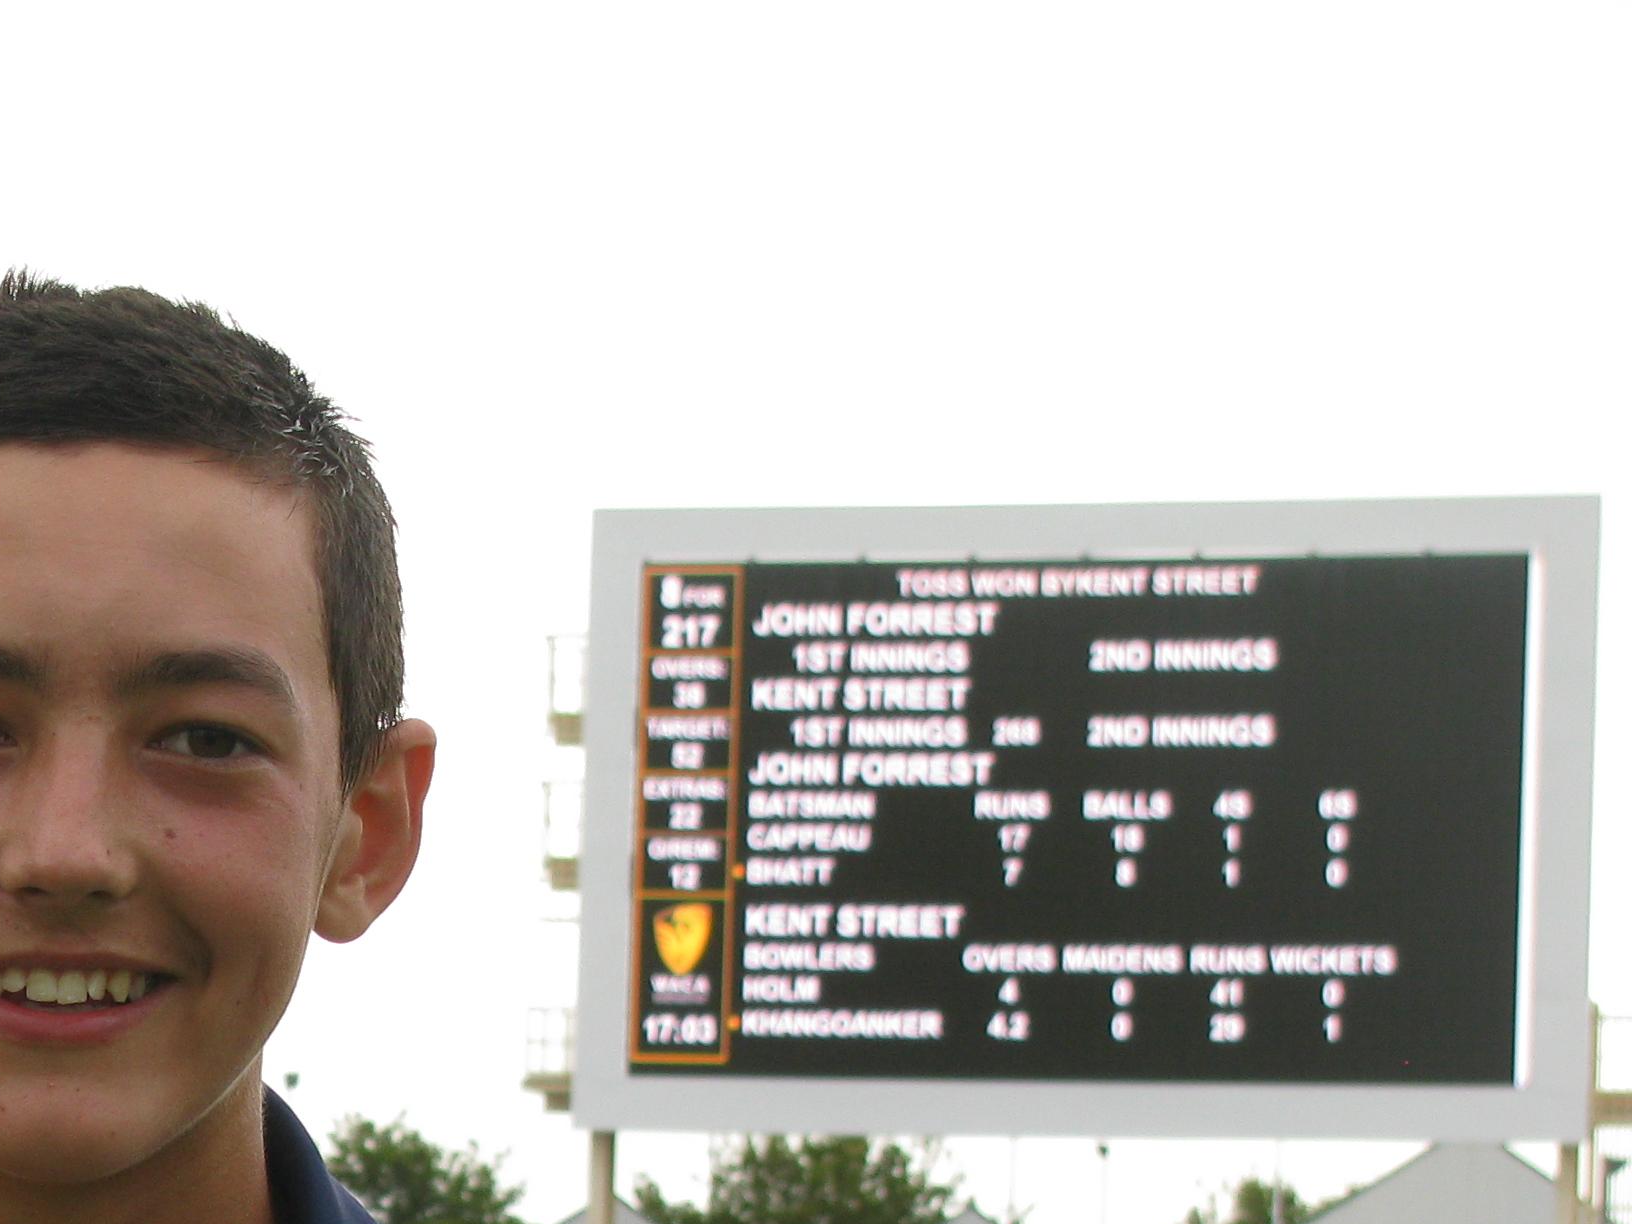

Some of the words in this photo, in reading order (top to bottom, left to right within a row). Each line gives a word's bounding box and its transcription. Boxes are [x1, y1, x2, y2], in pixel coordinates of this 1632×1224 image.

[683, 584, 726, 609] FOR
[895, 568, 969, 599] TOSS
[970, 567, 1039, 598] WON
[1151, 564, 1259, 597] STREET
[661, 613, 721, 649] 217
[752, 602, 844, 638] JOHN
[846, 600, 999, 637] FORREST
[791, 640, 847, 674] 1ST
[849, 639, 970, 674] INNINGS
[1088, 638, 1152, 673] 2ND
[1153, 637, 1278, 672] INNINGS
[751, 676, 839, 712] KENT
[842, 676, 970, 712] STREET
[789, 715, 845, 749] 1ST
[847, 715, 968, 749] INNINGS
[1086, 715, 1150, 748] 2ND
[1151, 713, 1275, 748] INNINGS
[747, 751, 839, 787] JOHN
[841, 751, 994, 787] FORREST
[747, 789, 876, 820] BATSMAN
[974, 790, 1051, 820] RUNS
[1082, 790, 1172, 821] BALLS
[1212, 790, 1251, 820] 4S
[998, 822, 1030, 852] 17
[1002, 857, 1022, 886] 7
[744, 903, 834, 938] KENT
[836, 903, 964, 939] STREET
[743, 941, 875, 972] BOWLERS
[962, 943, 1057, 974] OVERS
[1062, 944, 1184, 975] MAIDENS
[1189, 944, 1268, 975] RUNS
[1269, 944, 1397, 976] WICKETS
[742, 974, 821, 1004] HOLM
[998, 977, 1019, 1005] 4
